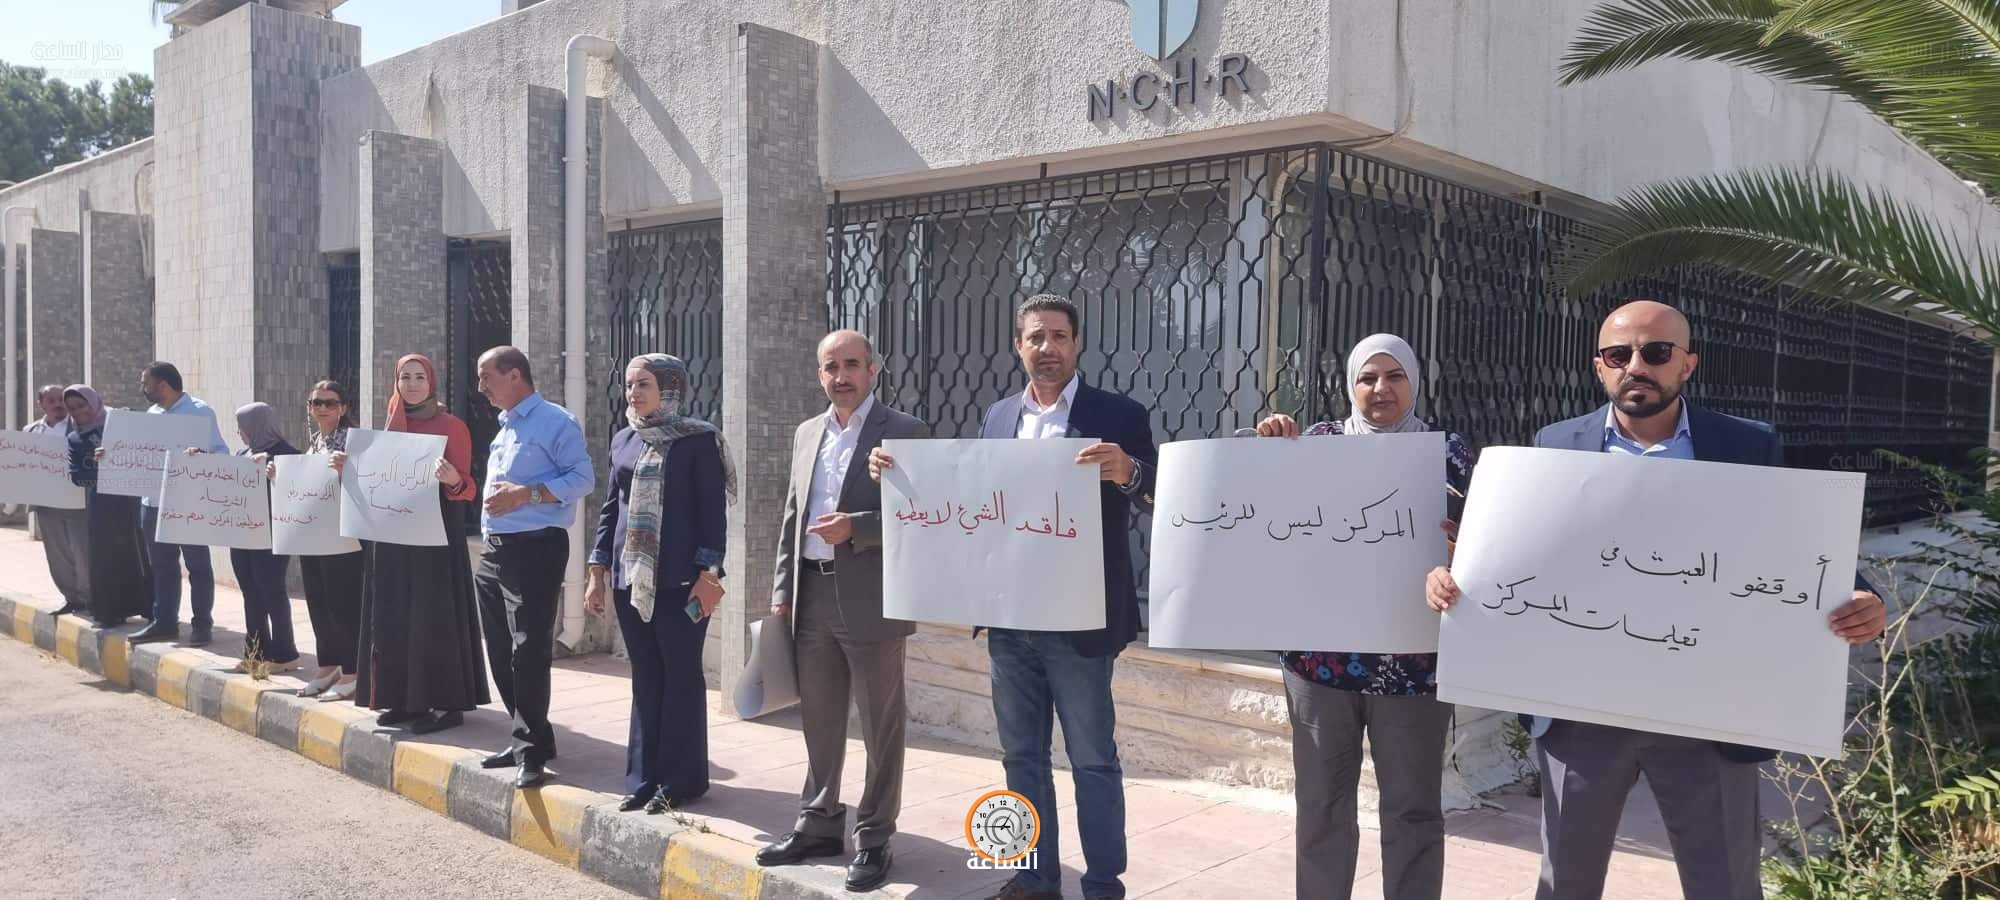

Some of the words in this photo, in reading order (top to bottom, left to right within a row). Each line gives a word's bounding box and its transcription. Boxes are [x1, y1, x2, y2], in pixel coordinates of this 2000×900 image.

[1015, 491, 1078, 539] فاقد
[1171, 501, 1256, 532] للرئيس
[1267, 504, 1323, 541] ليس
[1331, 488, 1416, 544] المركز
[1624, 551, 1718, 585] العبث
[1481, 575, 1569, 616] المركز
[1549, 609, 1702, 651] تعليمات
